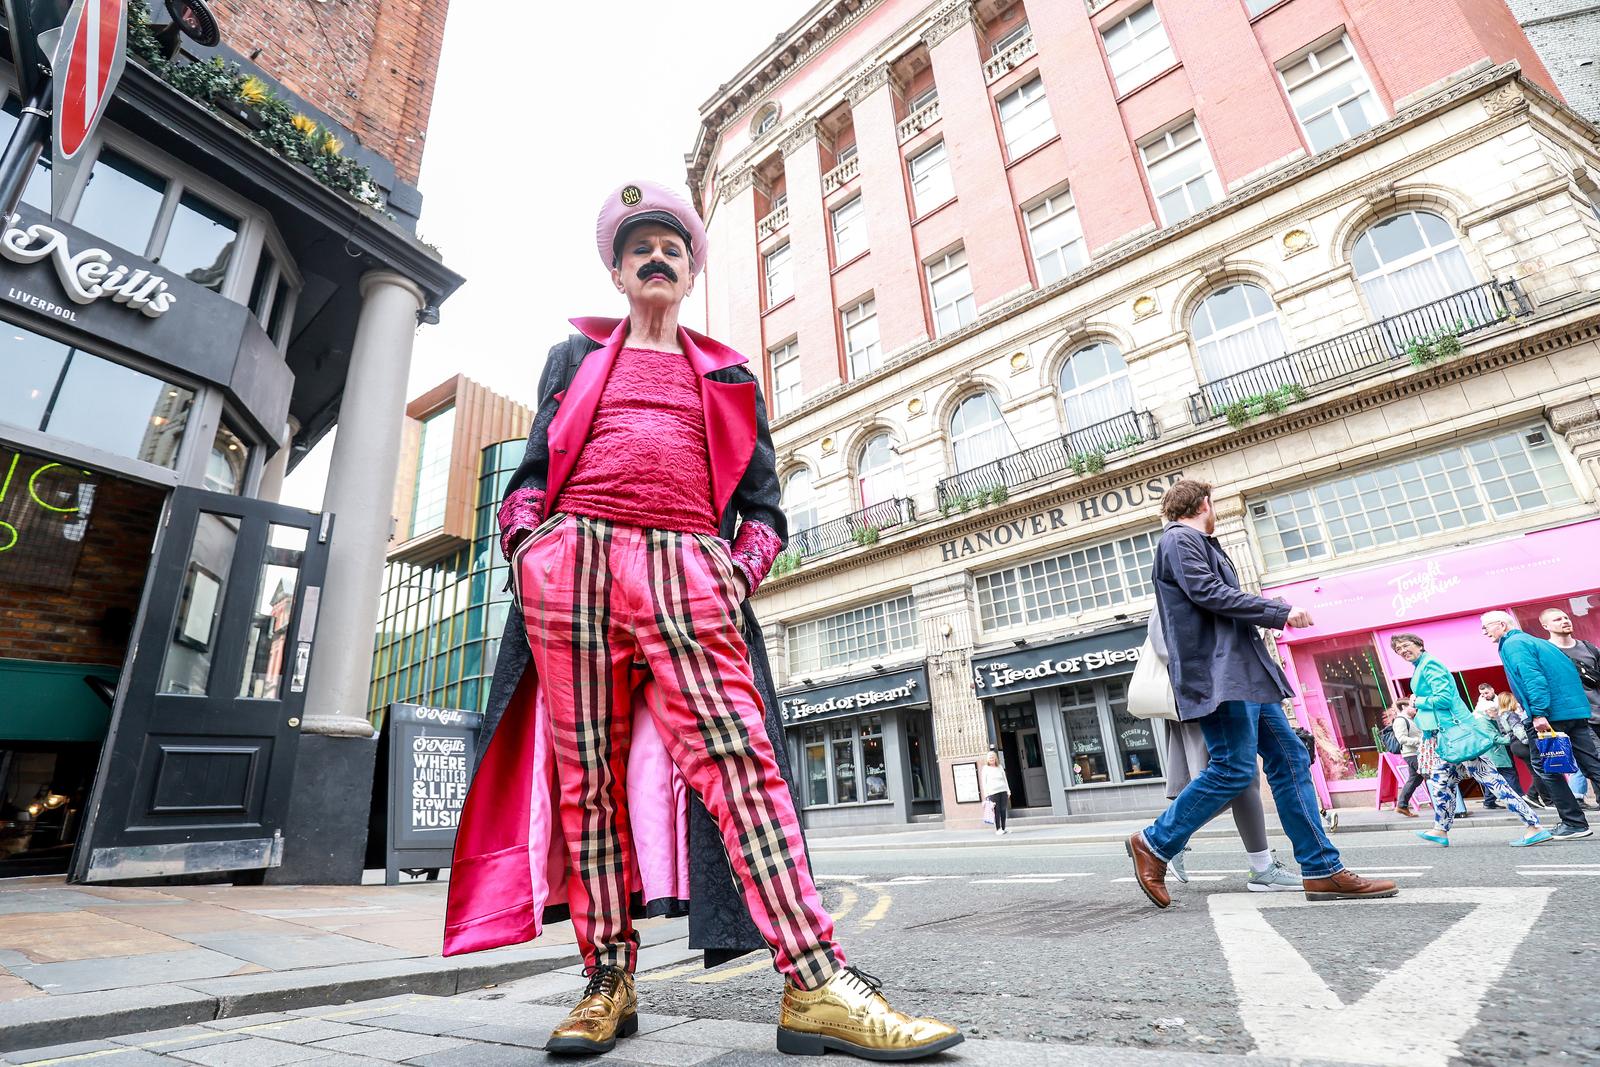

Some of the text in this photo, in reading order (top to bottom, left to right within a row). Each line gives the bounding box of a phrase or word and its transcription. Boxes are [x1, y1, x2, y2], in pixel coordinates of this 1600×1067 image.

[0, 212, 177, 318] 'Neill's
[8, 287, 77, 322] LIVERPOOL
[939, 507, 1068, 562] HANOVER
[1387, 560, 1446, 593] Tonight
[1391, 575, 1461, 617] Josephine
[989, 661, 1009, 671] the
[989, 658, 1056, 688] Head
[1083, 646, 1142, 671] Stea
[791, 696, 838, 719] Head
[855, 685, 911, 708] Steam
[792, 697, 807, 706] the
[413, 753, 466, 771] WHERE
[413, 767, 466, 783] LAUGHTER
[446, 799, 465, 809] LIK
